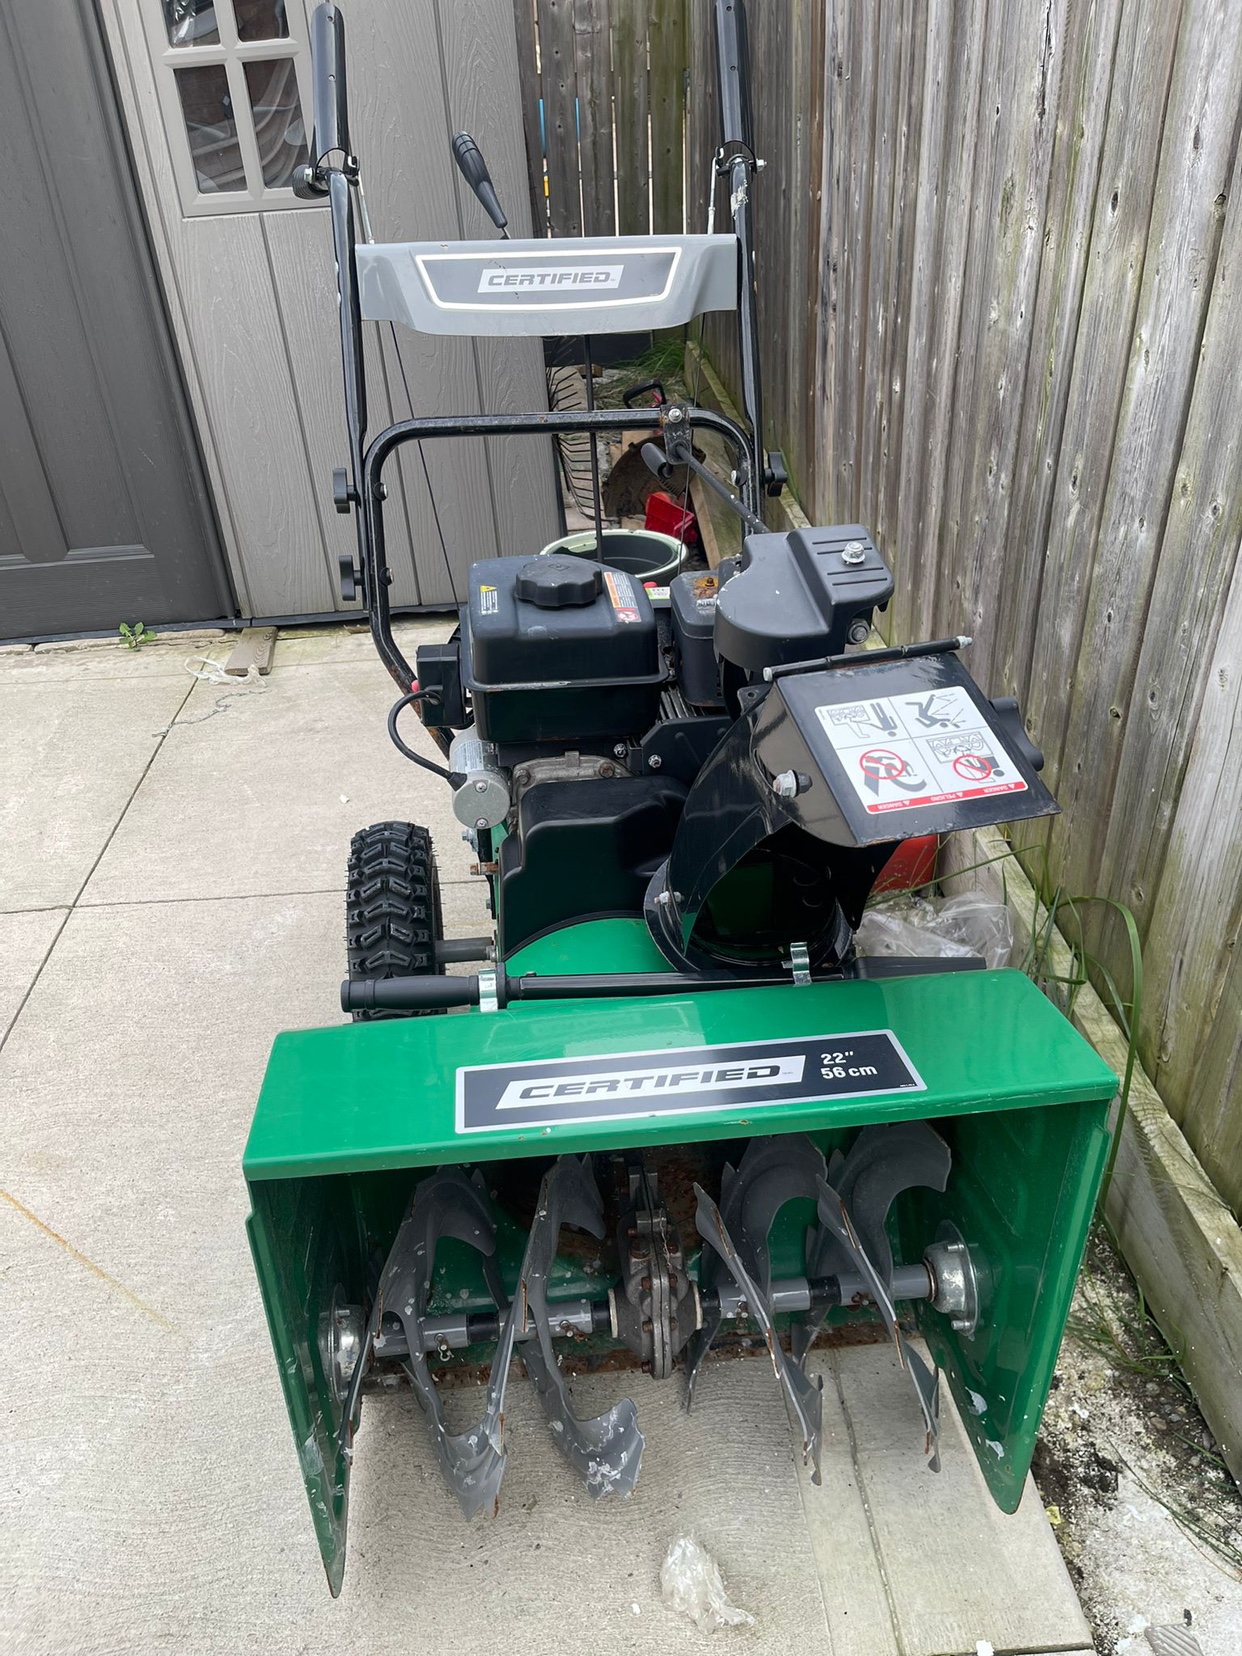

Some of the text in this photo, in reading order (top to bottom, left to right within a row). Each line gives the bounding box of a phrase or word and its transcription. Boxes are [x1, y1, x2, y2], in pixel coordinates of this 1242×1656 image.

[488, 271, 611, 286] CERTIFIED
[983, 784, 1009, 793] DANGER
[930, 793, 956, 802] PELIGRO
[877, 800, 903, 810] DANGER
[821, 1051, 854, 1065] 22"
[821, 1066, 878, 1080] 56 cm
[519, 1064, 781, 1100] CERTIFIED
